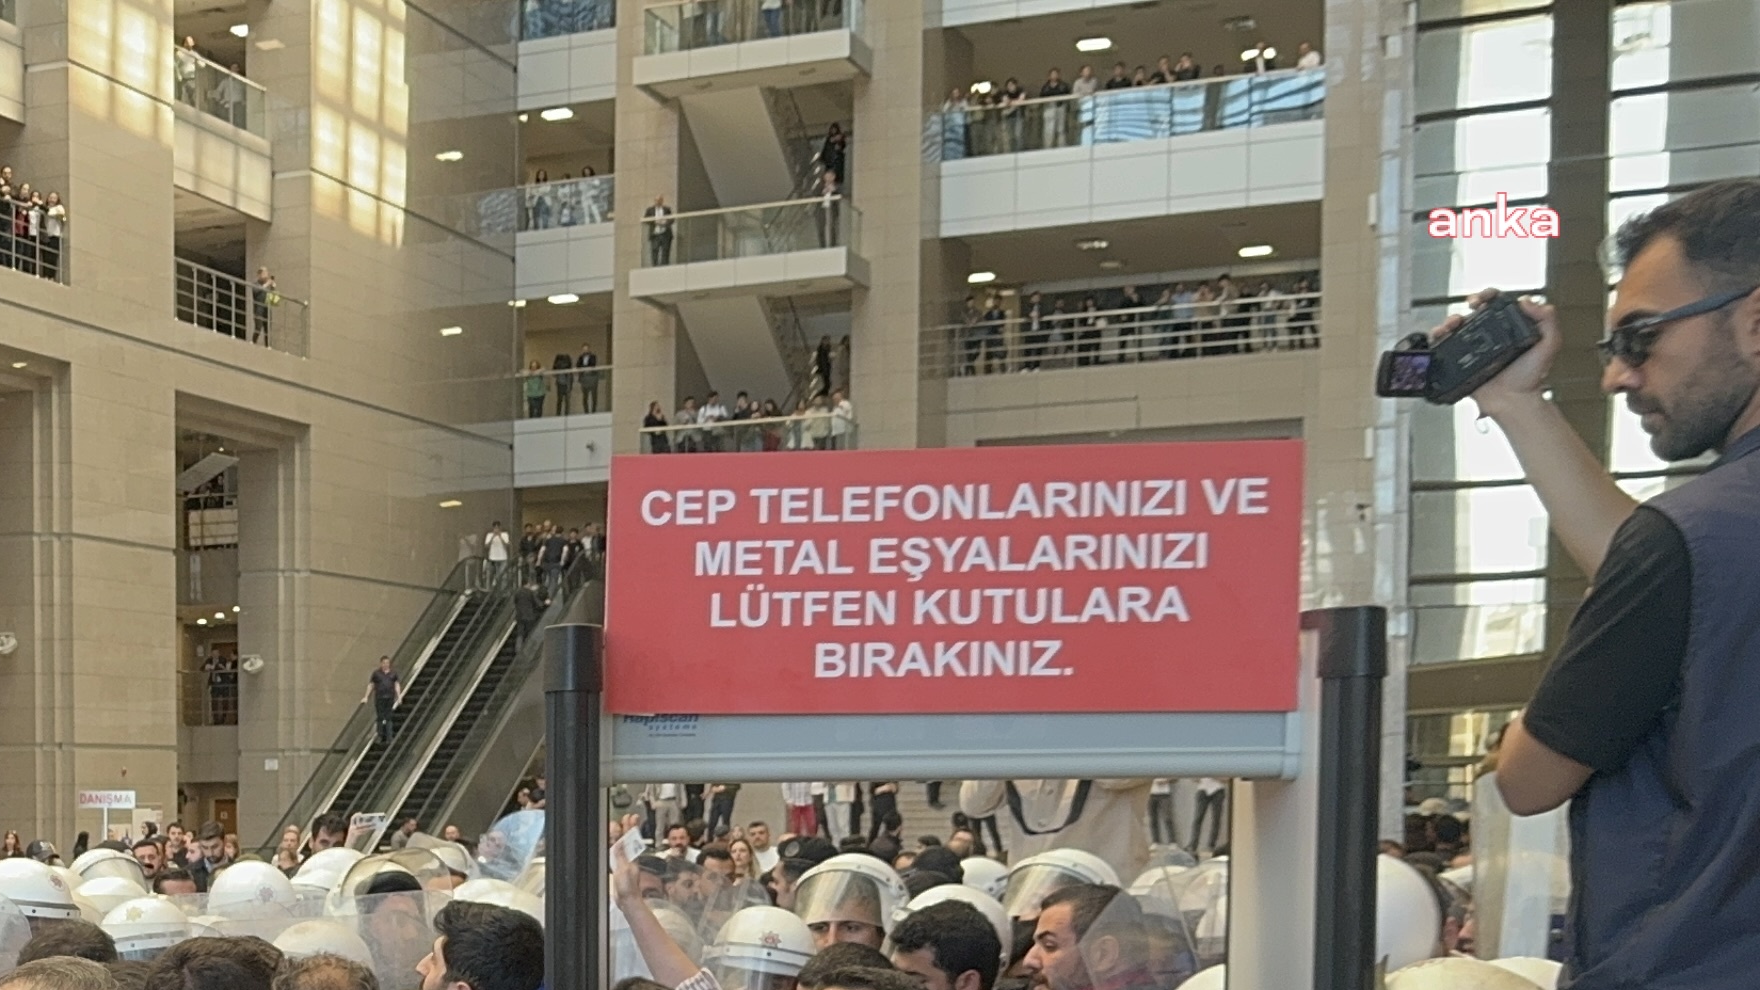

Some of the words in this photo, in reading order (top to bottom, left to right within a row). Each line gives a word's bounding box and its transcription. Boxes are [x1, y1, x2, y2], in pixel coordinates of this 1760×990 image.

[641, 489, 736, 526] CEP
[750, 480, 1187, 524] TELEFONLARINIZI
[1201, 478, 1269, 515] VE
[695, 539, 854, 576] METAL
[868, 532, 1208, 582] EŞYALARINIZI
[710, 584, 896, 628] LÜTFEN
[913, 586, 1190, 626] KUTULARA
[814, 639, 1075, 679] BIRAKINIZ.
[80, 793, 132, 806] DANIŞMA
